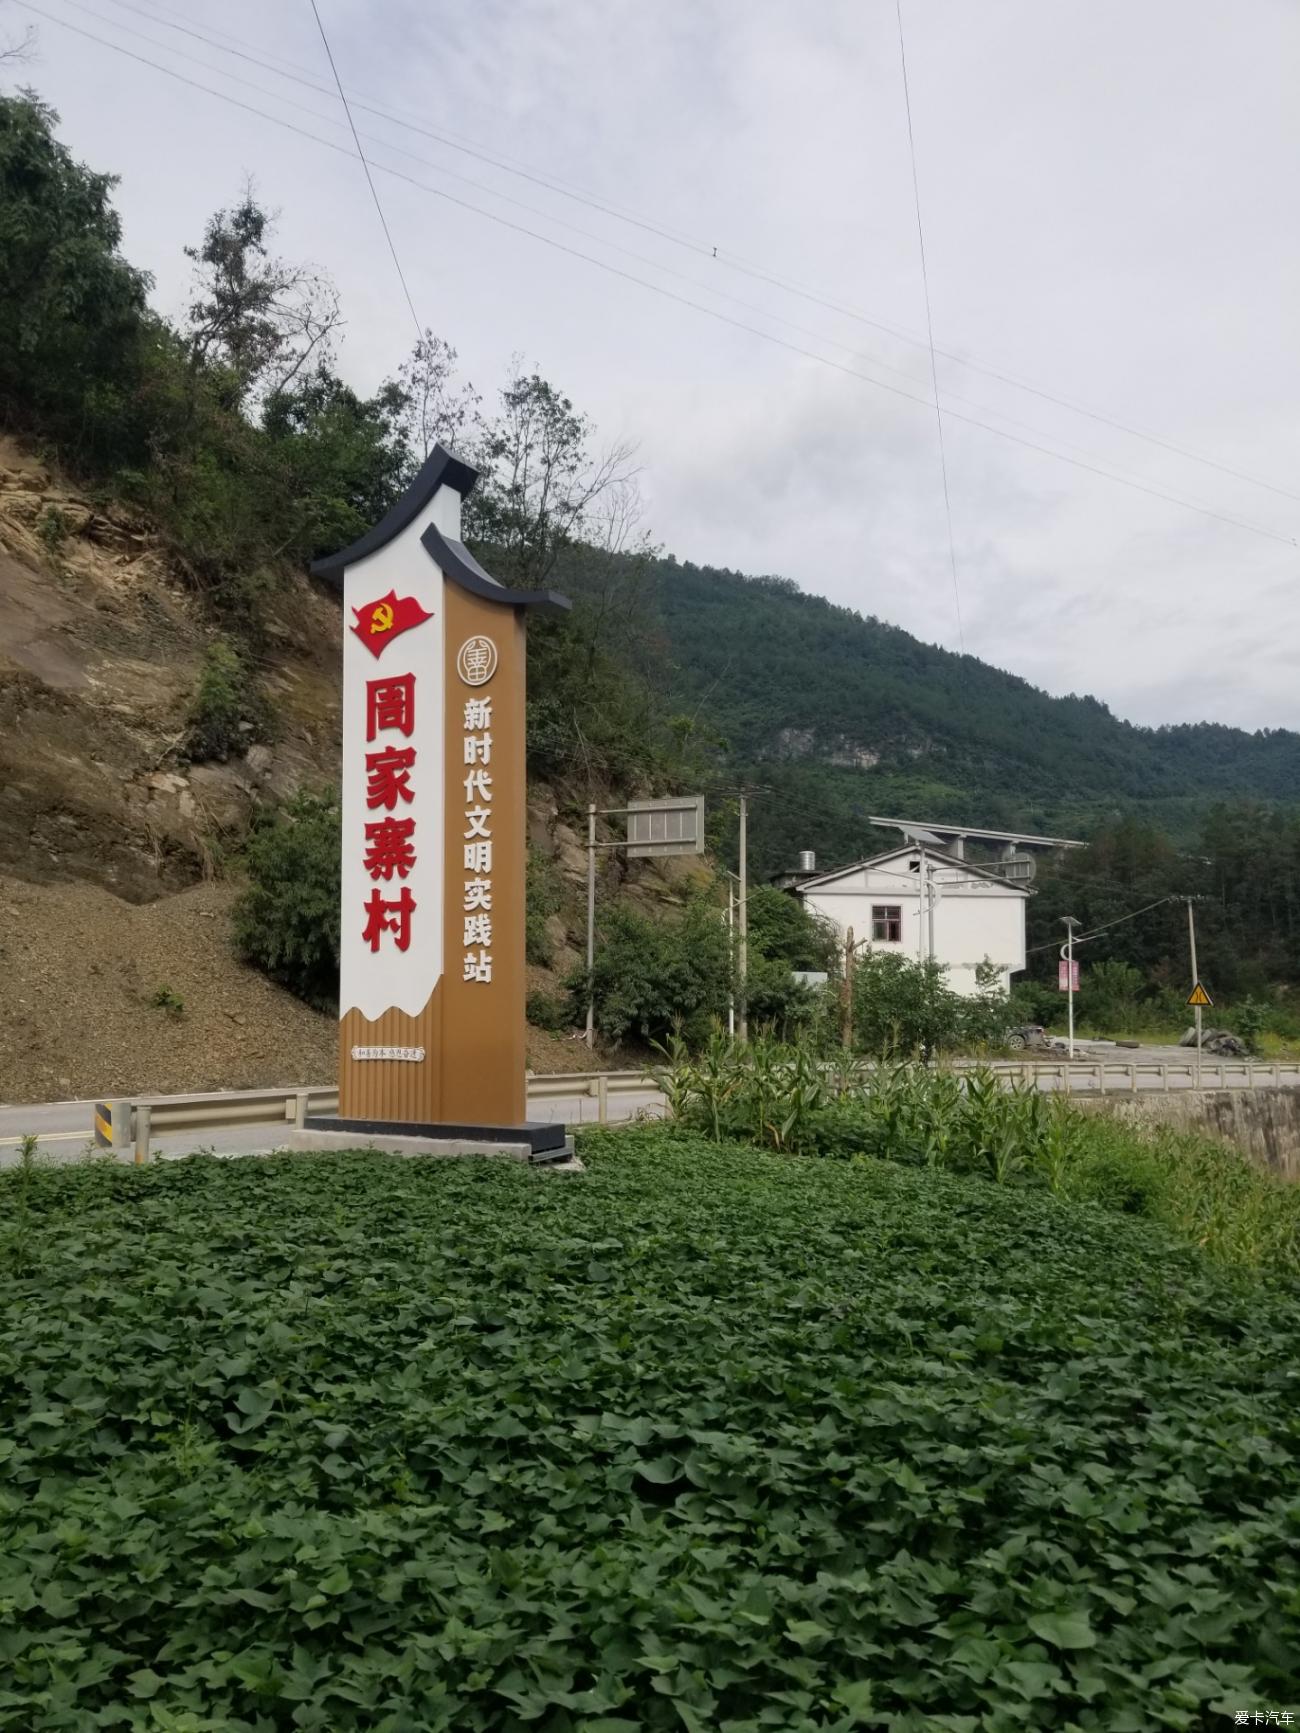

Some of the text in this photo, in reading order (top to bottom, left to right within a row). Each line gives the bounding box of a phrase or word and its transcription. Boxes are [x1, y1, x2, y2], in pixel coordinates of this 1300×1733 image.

[363, 672, 416, 952] 周家寨村
[462, 696, 493, 984] 新时代文明实践站
